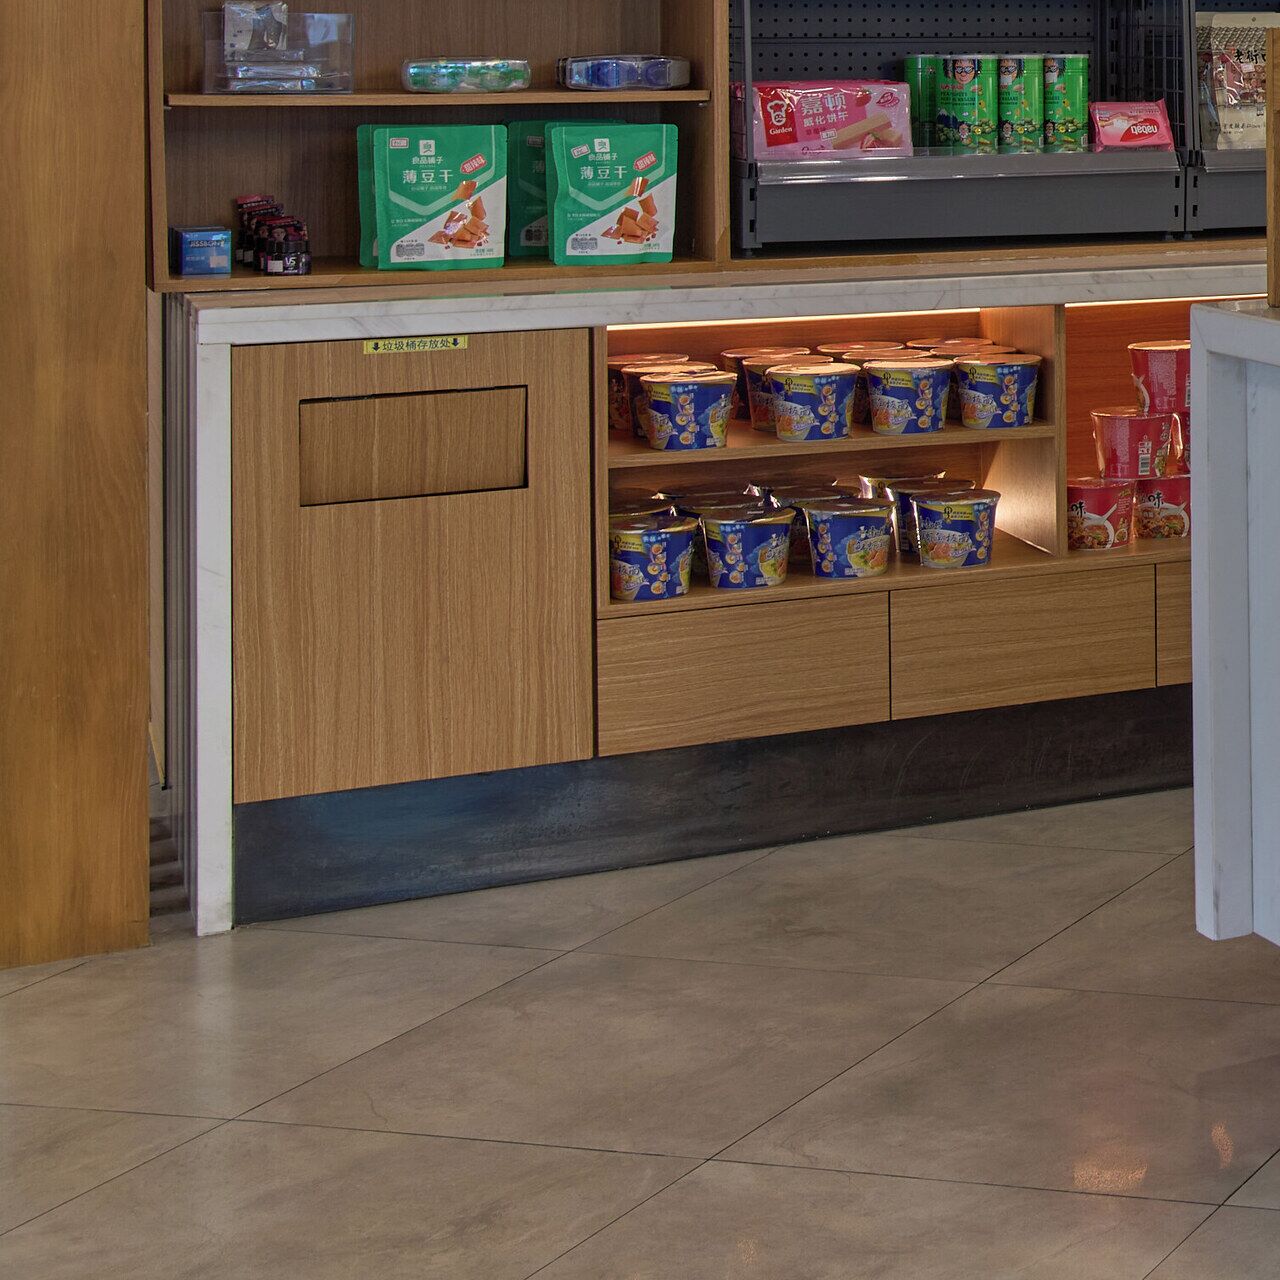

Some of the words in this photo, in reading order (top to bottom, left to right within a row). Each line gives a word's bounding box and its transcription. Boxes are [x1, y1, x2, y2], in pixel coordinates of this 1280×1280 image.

[801, 93, 846, 115] 嘉顿
[769, 127, 793, 135] Garden
[1131, 124, 1158, 134] nabati
[403, 169, 453, 183] 薄豆干
[580, 166, 628, 179] 薄豆干
[382, 339, 450, 351] 垃圾桶存放处
